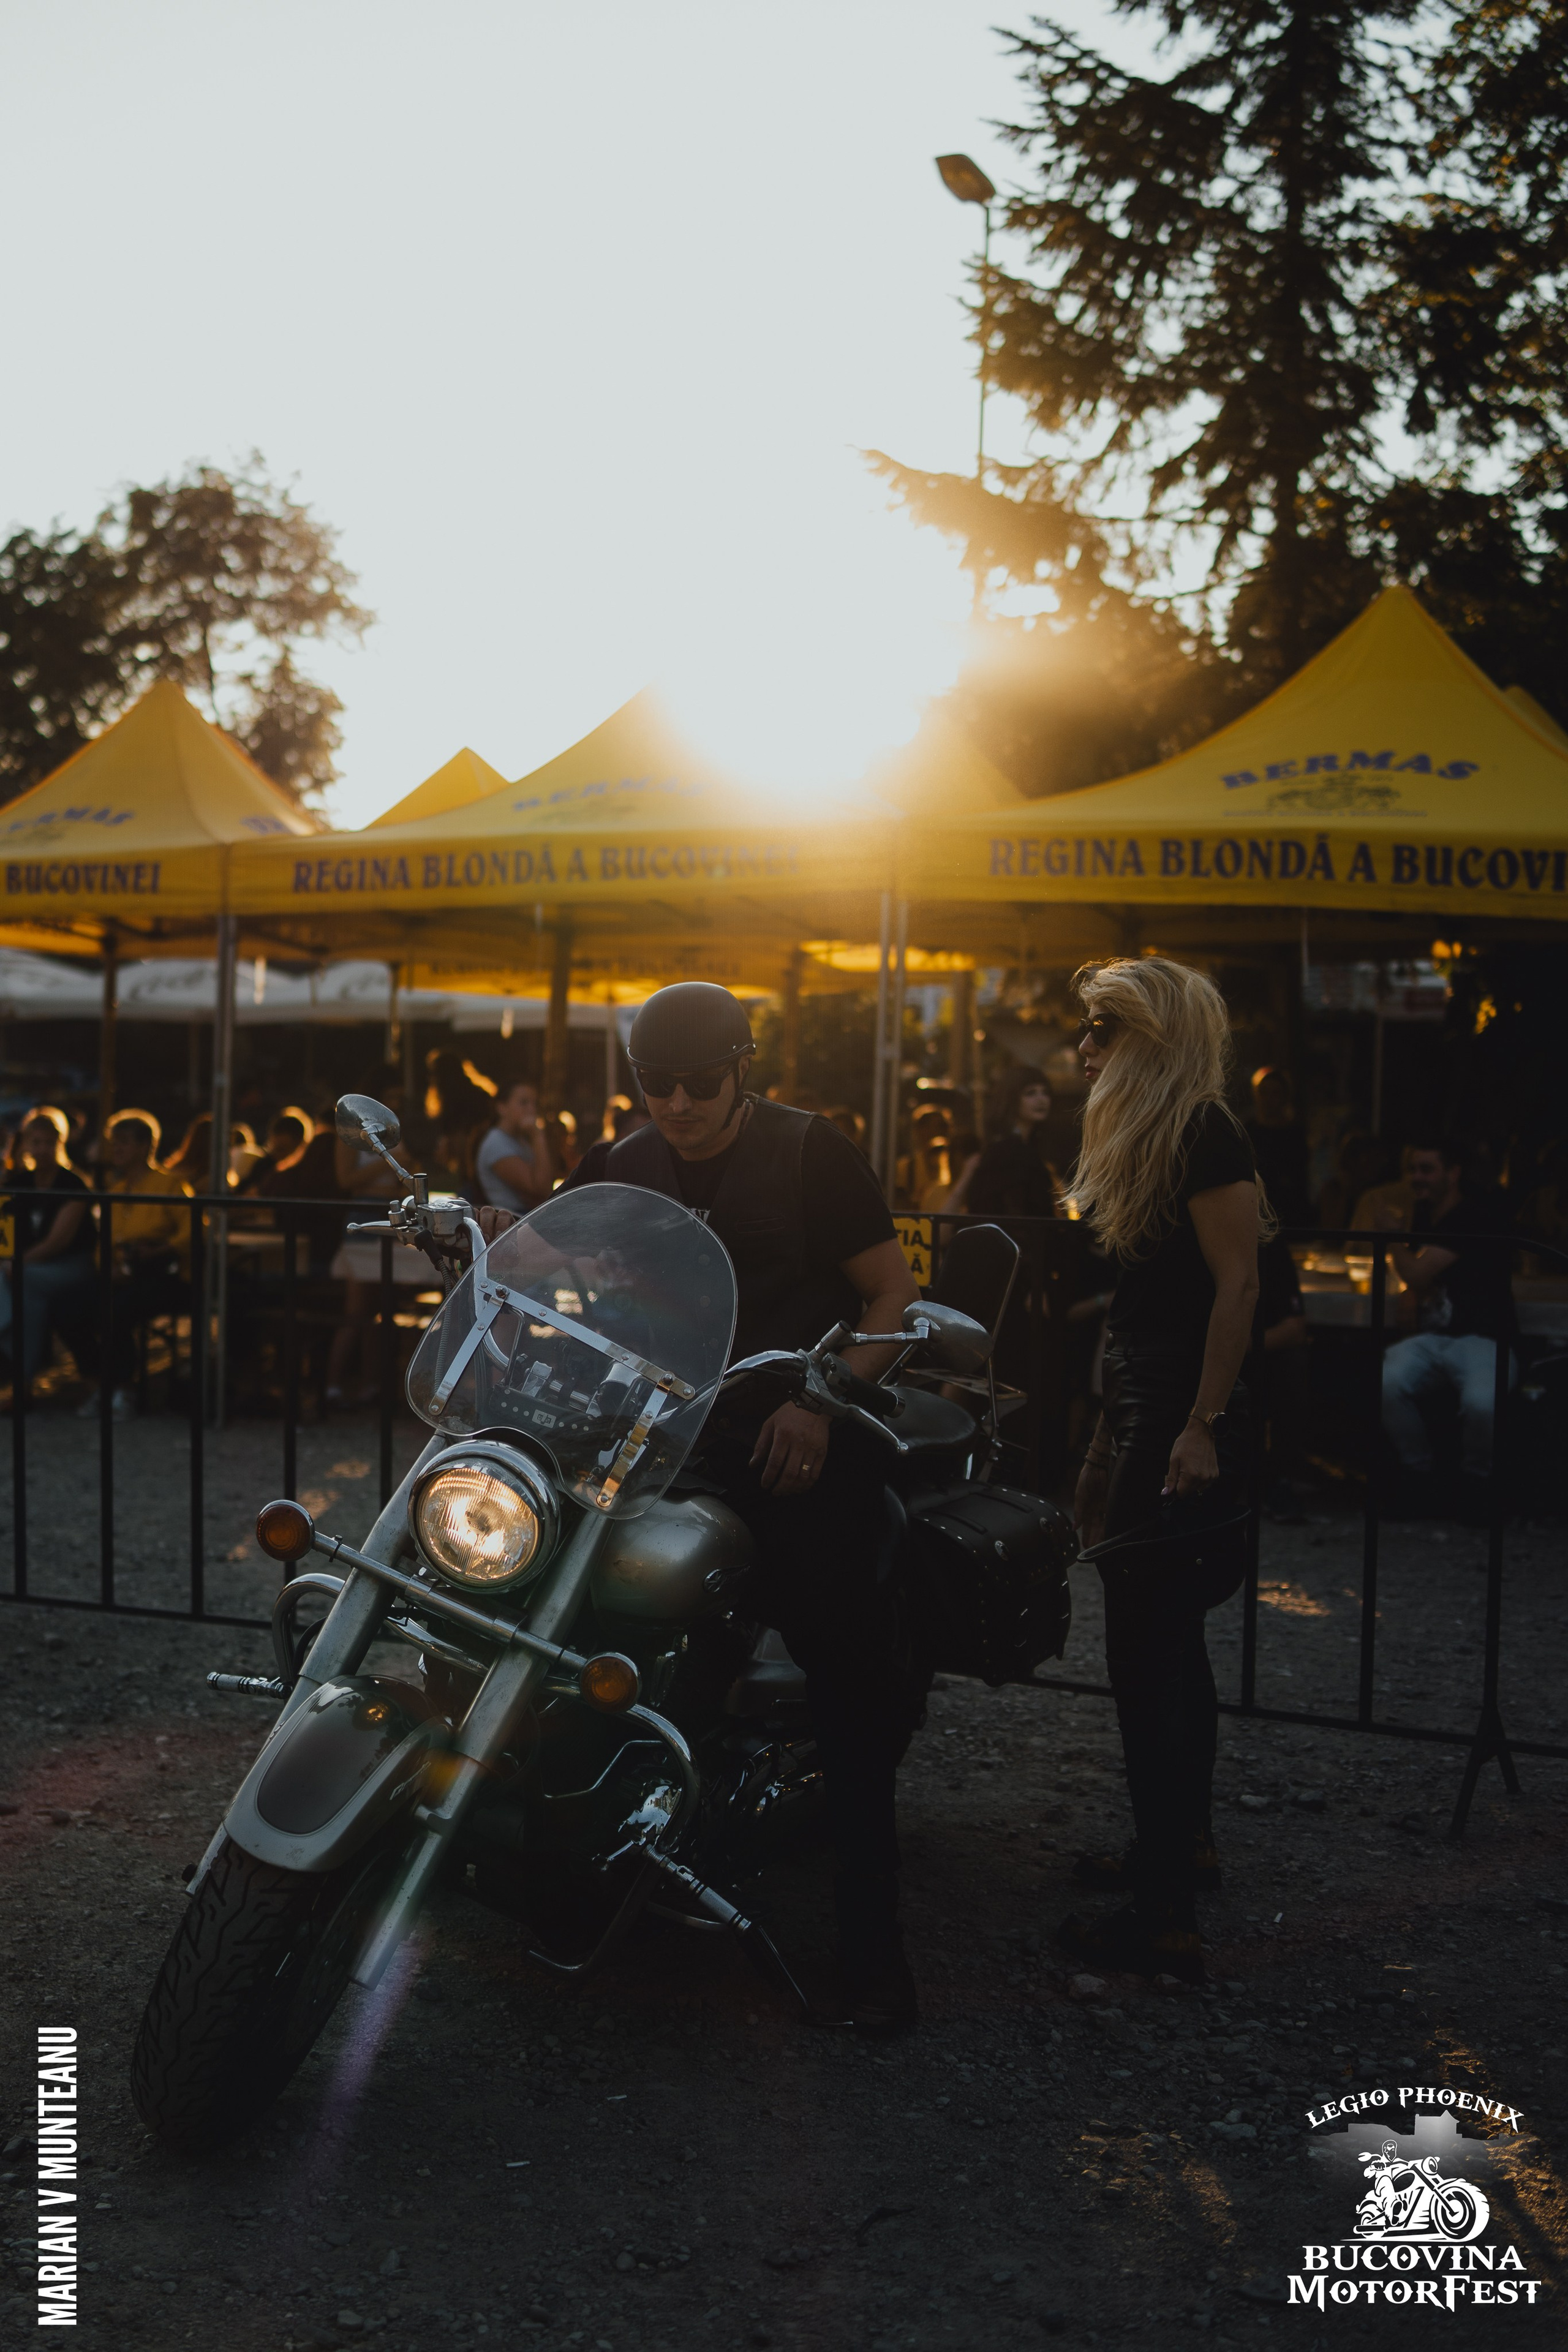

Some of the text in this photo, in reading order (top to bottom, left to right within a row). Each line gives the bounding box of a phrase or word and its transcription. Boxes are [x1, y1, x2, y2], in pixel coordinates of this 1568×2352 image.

[1221, 750, 1480, 788] BERMAS
[6, 861, 162, 895] BUCOVINEI
[292, 858, 412, 894] REGINA
[566, 847, 590, 883] A
[599, 845, 801, 881] BUCOVINEI
[988, 837, 1145, 878] REGINA
[1348, 842, 1378, 883] A
